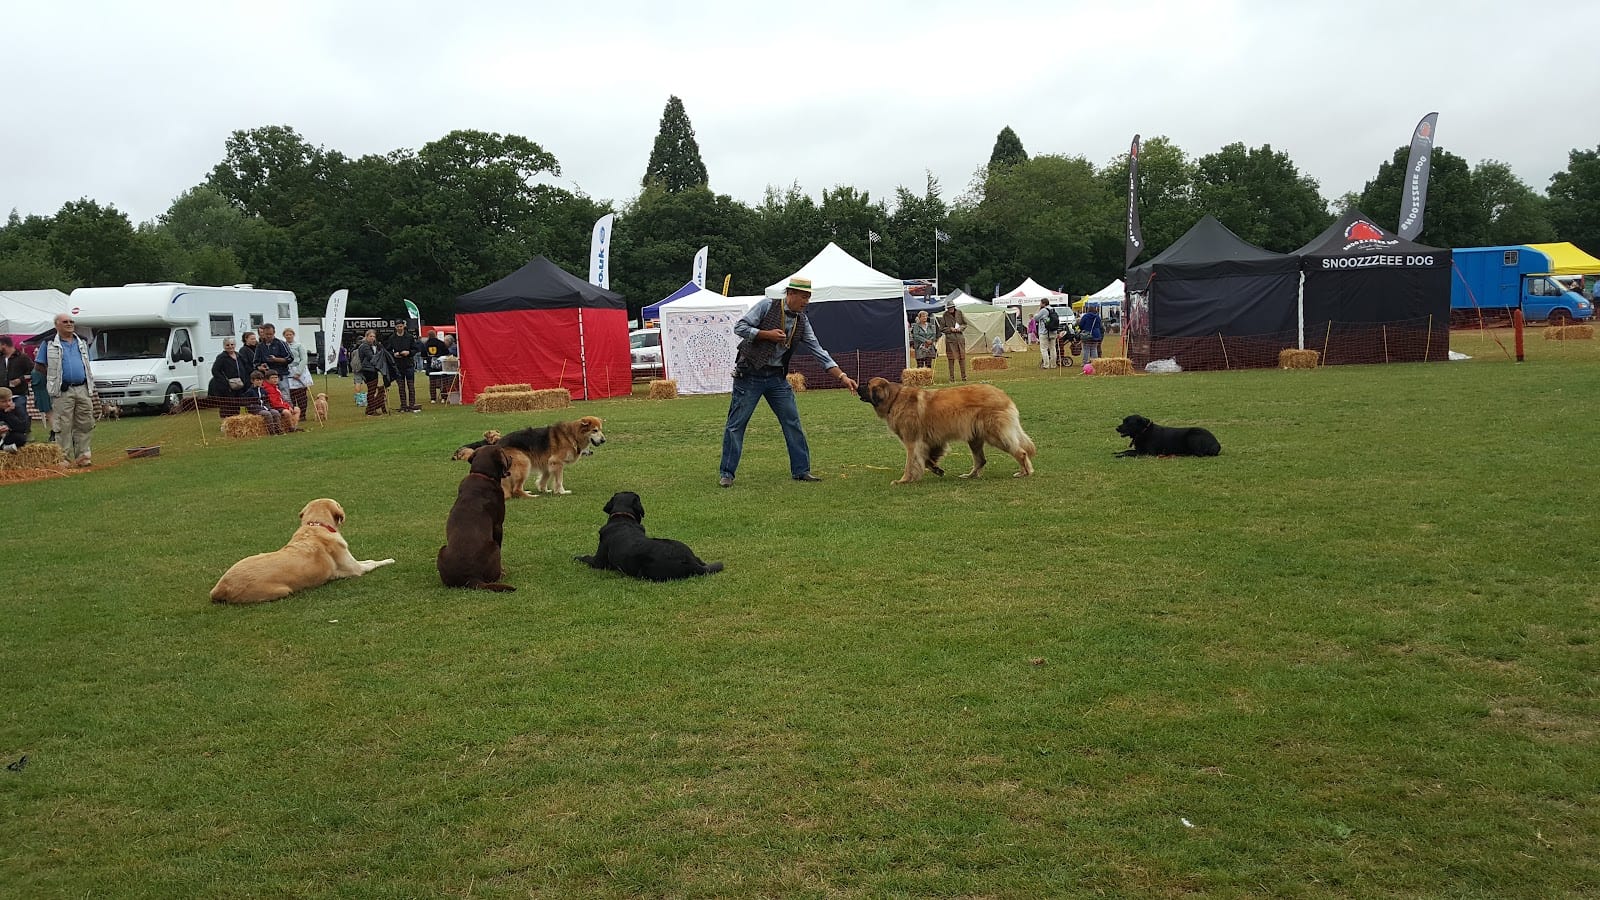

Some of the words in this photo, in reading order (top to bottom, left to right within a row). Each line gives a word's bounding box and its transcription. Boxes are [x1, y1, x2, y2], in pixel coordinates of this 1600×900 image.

[1322, 255, 1402, 269] SNOOZZZEEE
[1406, 255, 1434, 266] DOG
[346, 320, 388, 329] LICENSED
